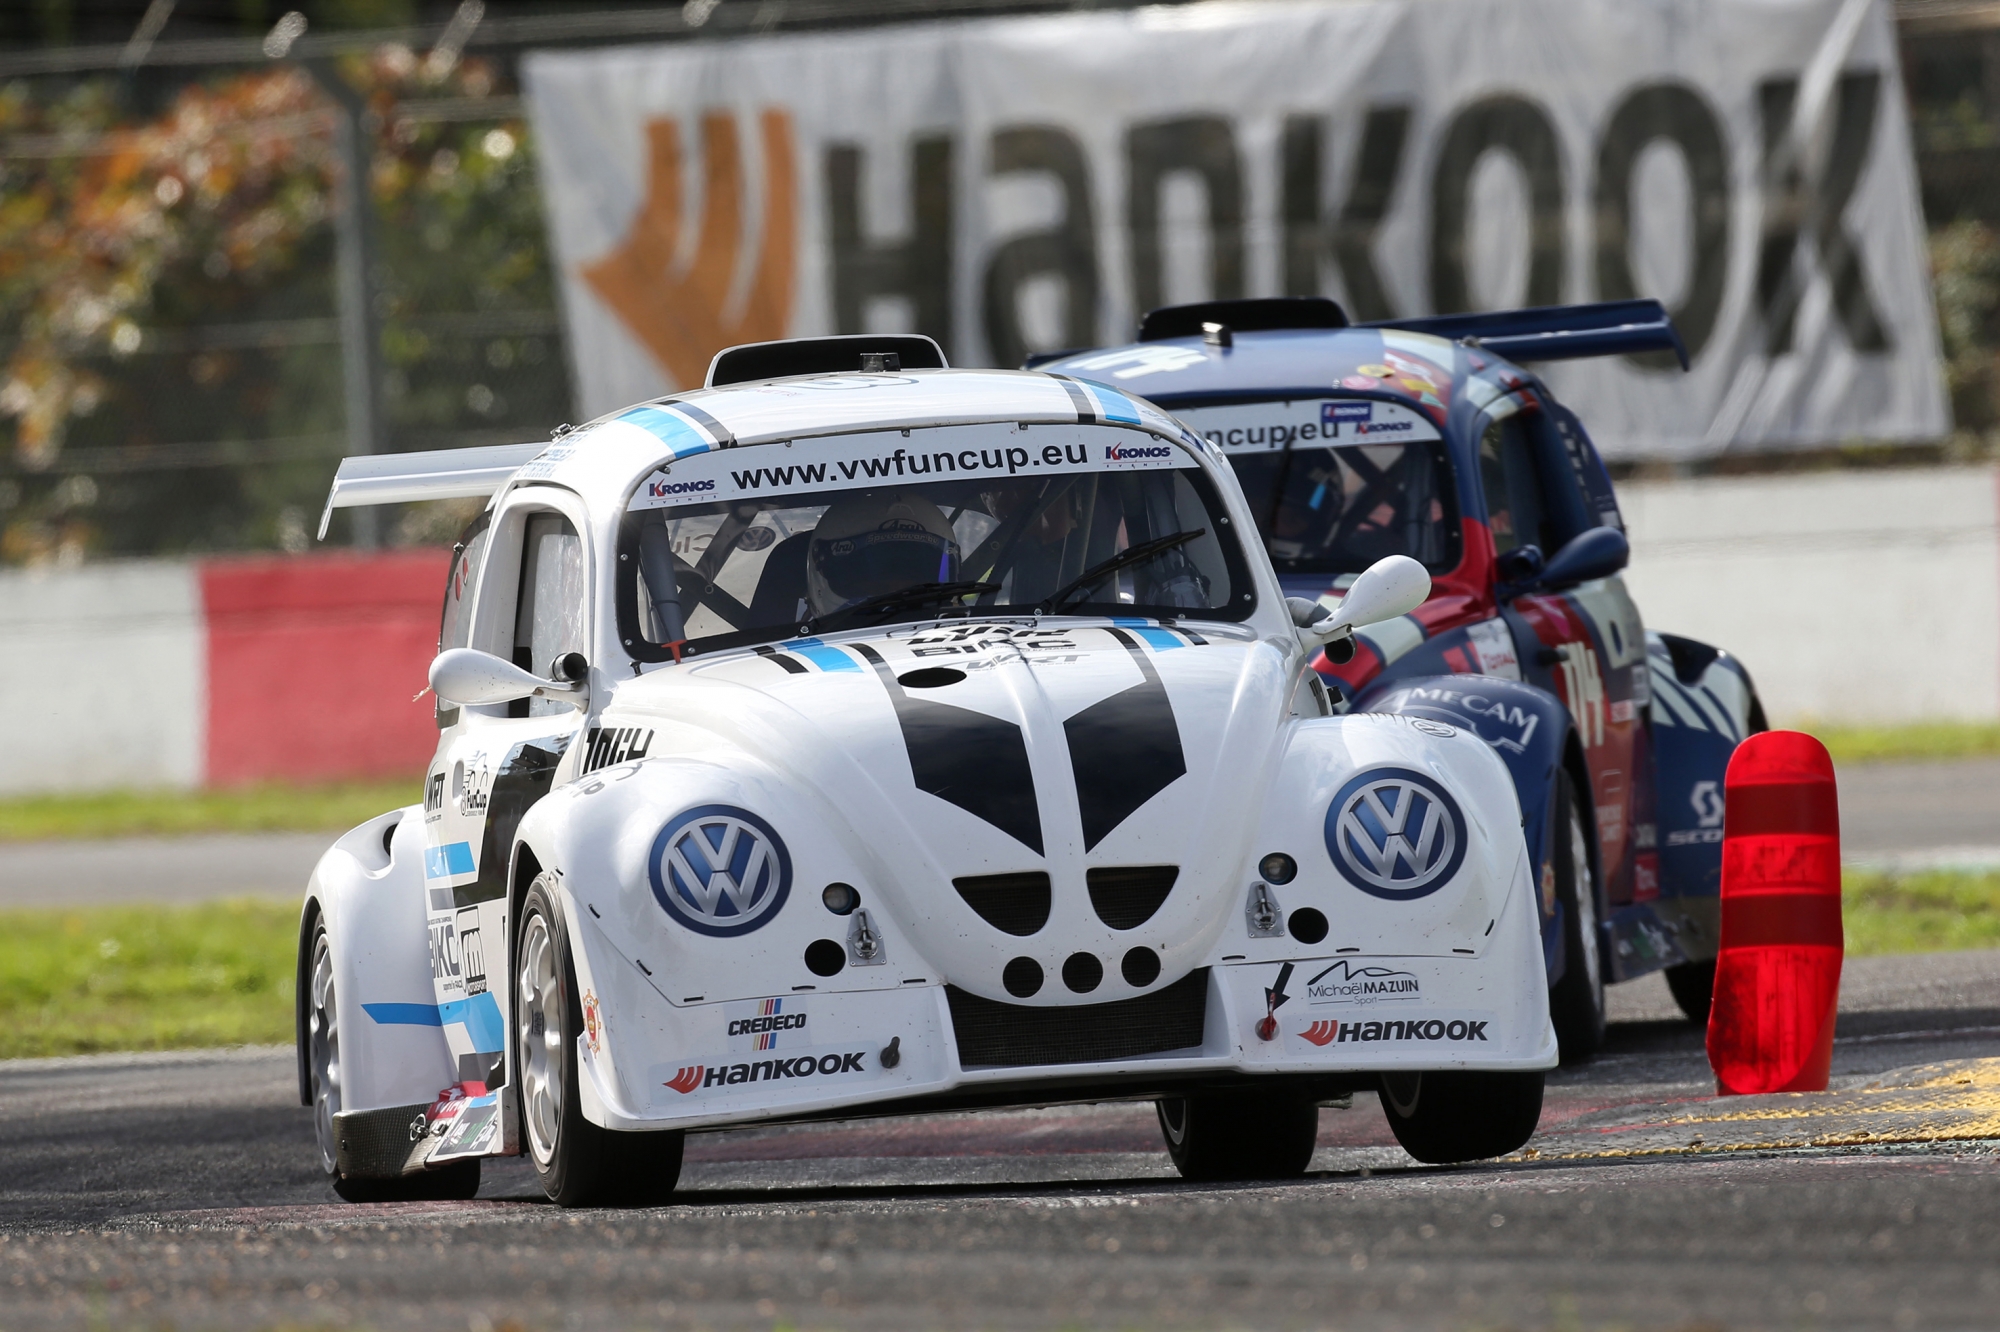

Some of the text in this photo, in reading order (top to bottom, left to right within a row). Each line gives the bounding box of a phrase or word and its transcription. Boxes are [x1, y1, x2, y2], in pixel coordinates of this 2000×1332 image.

[1105, 442, 1171, 460] KRONOS
[730, 443, 1088, 490] www.vwfuncup.eu
[649, 478, 716, 497] KRONOS
[1353, 995, 1378, 1006] Sport
[728, 1013, 807, 1036] CREDECO
